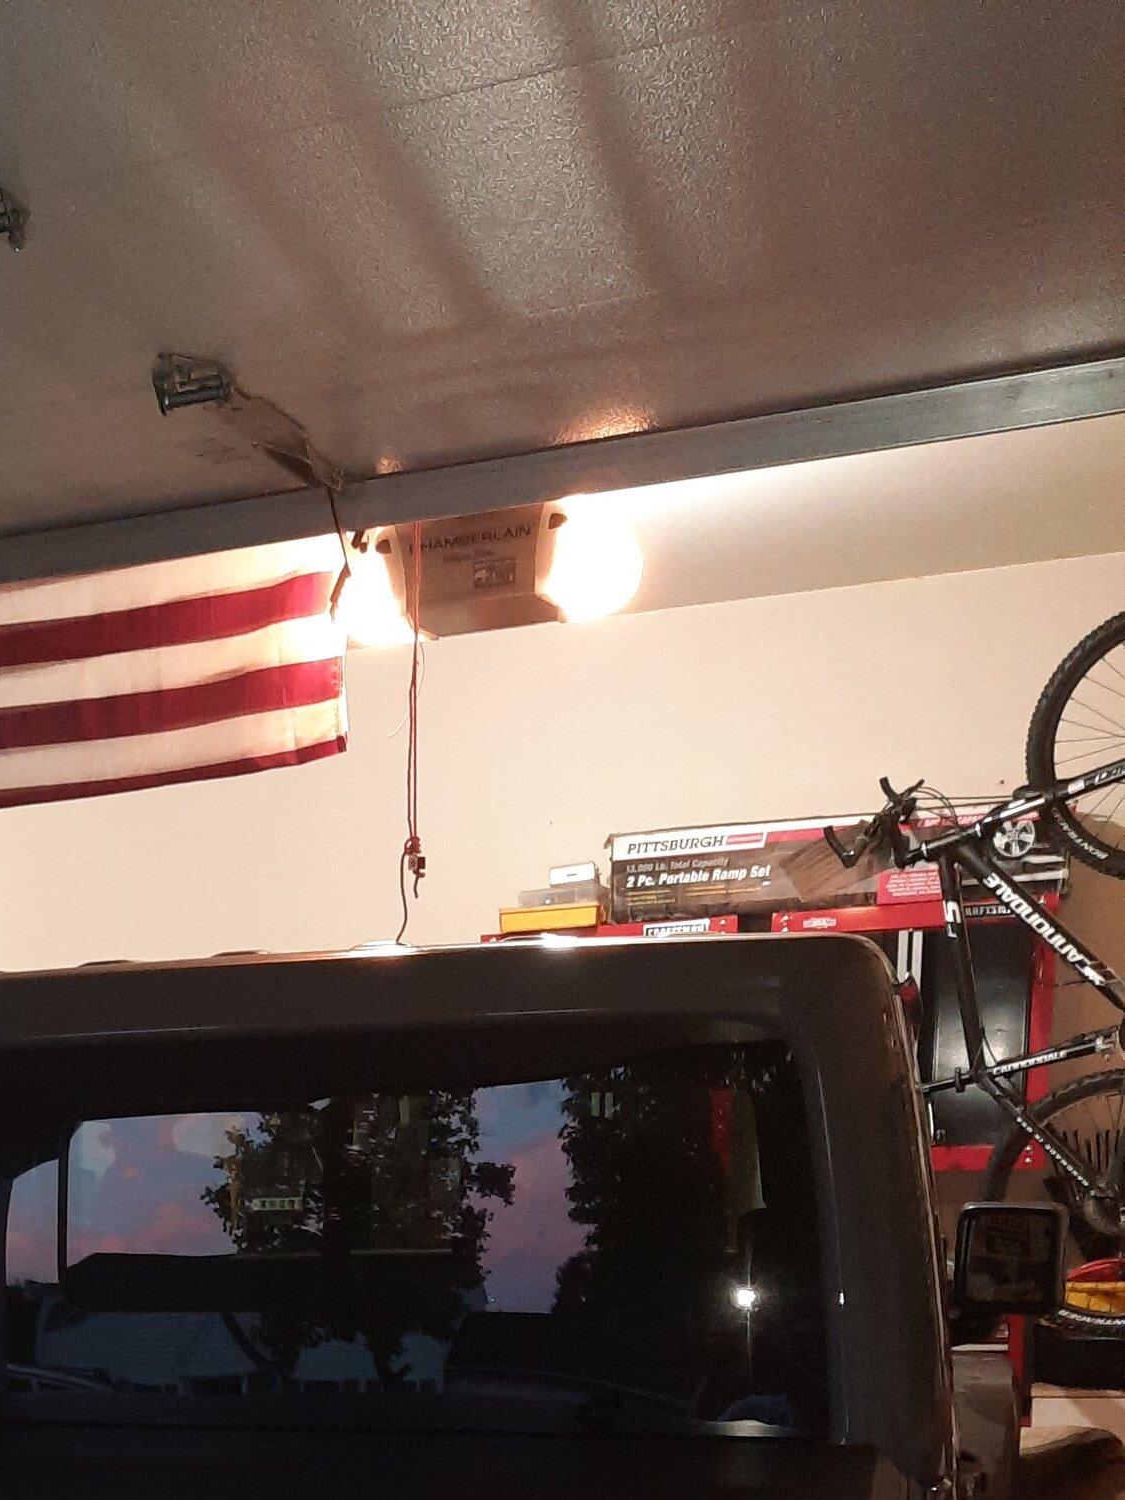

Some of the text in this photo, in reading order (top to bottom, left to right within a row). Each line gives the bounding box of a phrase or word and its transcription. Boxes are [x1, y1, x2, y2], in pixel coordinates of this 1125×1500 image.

[626, 835, 725, 855] PITTSBURGH
[670, 859, 691, 870] Total
[692, 855, 730, 868] Capacity
[626, 863, 772, 888] 2 Pc. Portable Ramp Set
